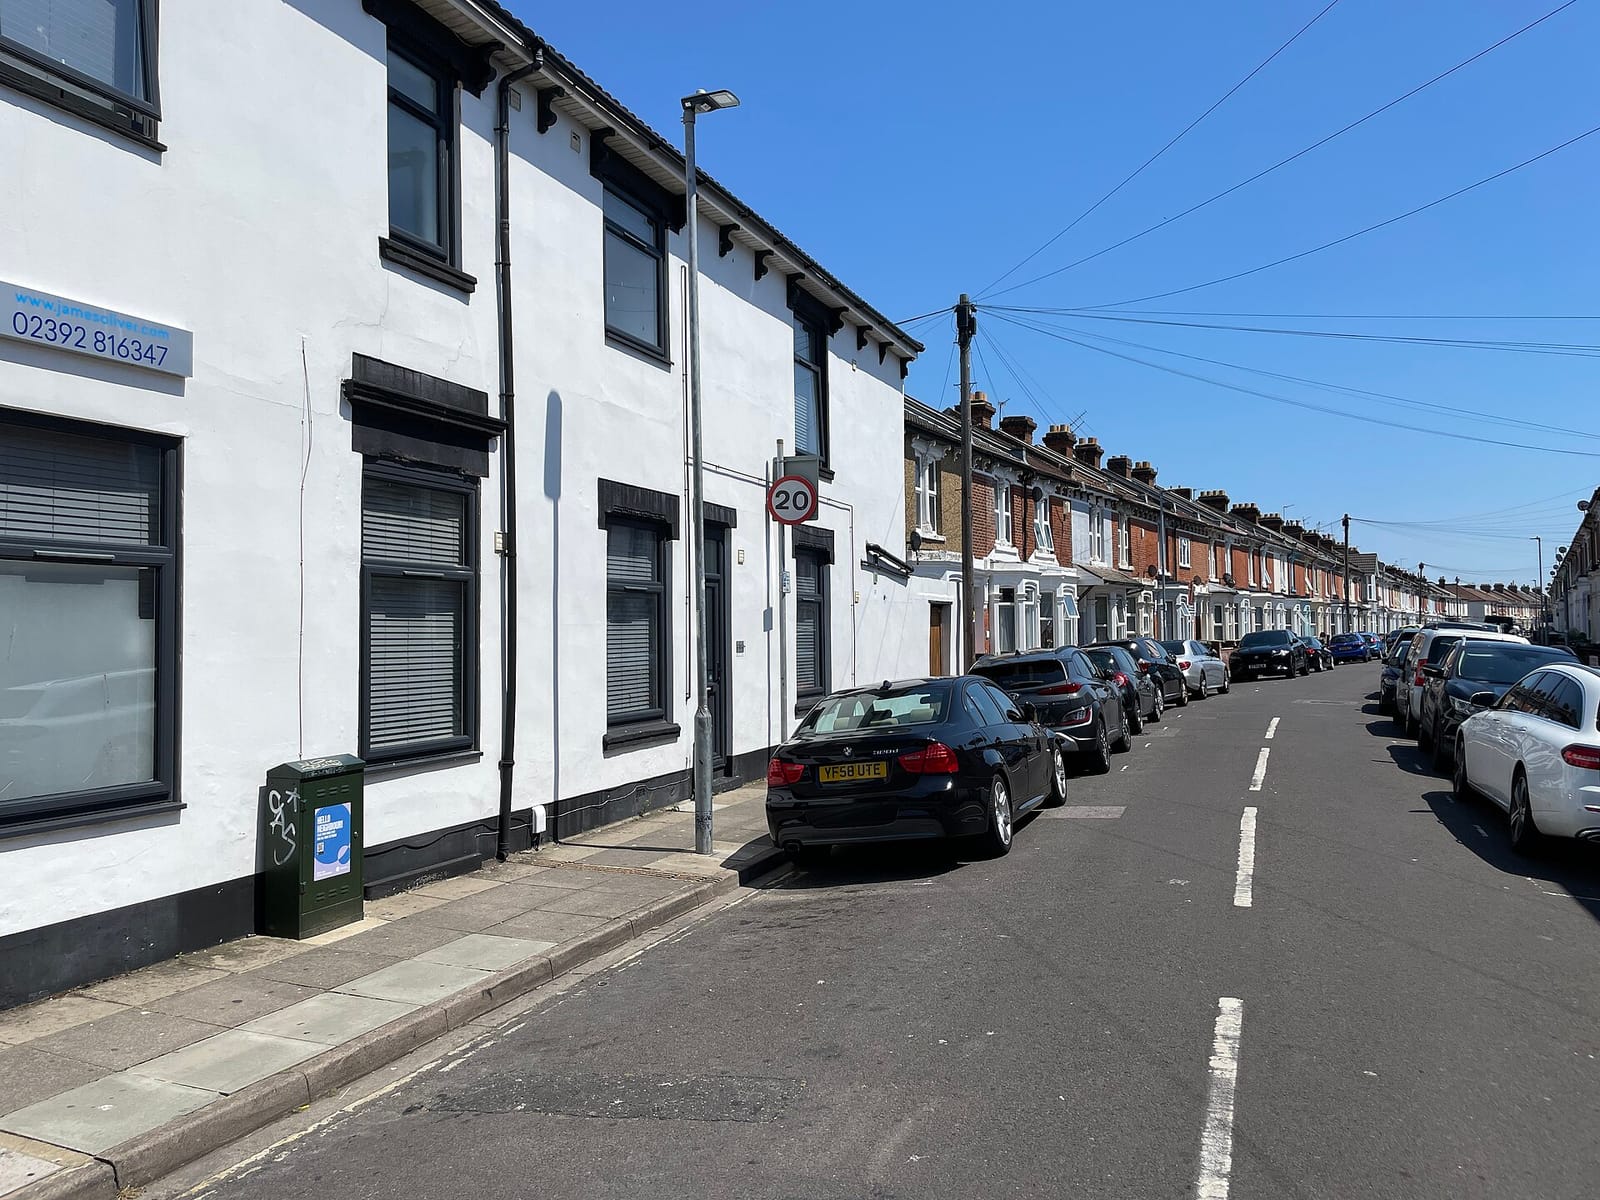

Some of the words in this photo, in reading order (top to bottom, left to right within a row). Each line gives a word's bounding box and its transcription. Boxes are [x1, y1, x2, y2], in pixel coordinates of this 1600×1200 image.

[13, 312, 87, 349] 02392
[94, 331, 168, 366] 816347
[775, 490, 809, 511] 20
[824, 765, 855, 780] YF58
[857, 763, 881, 776] UTE
